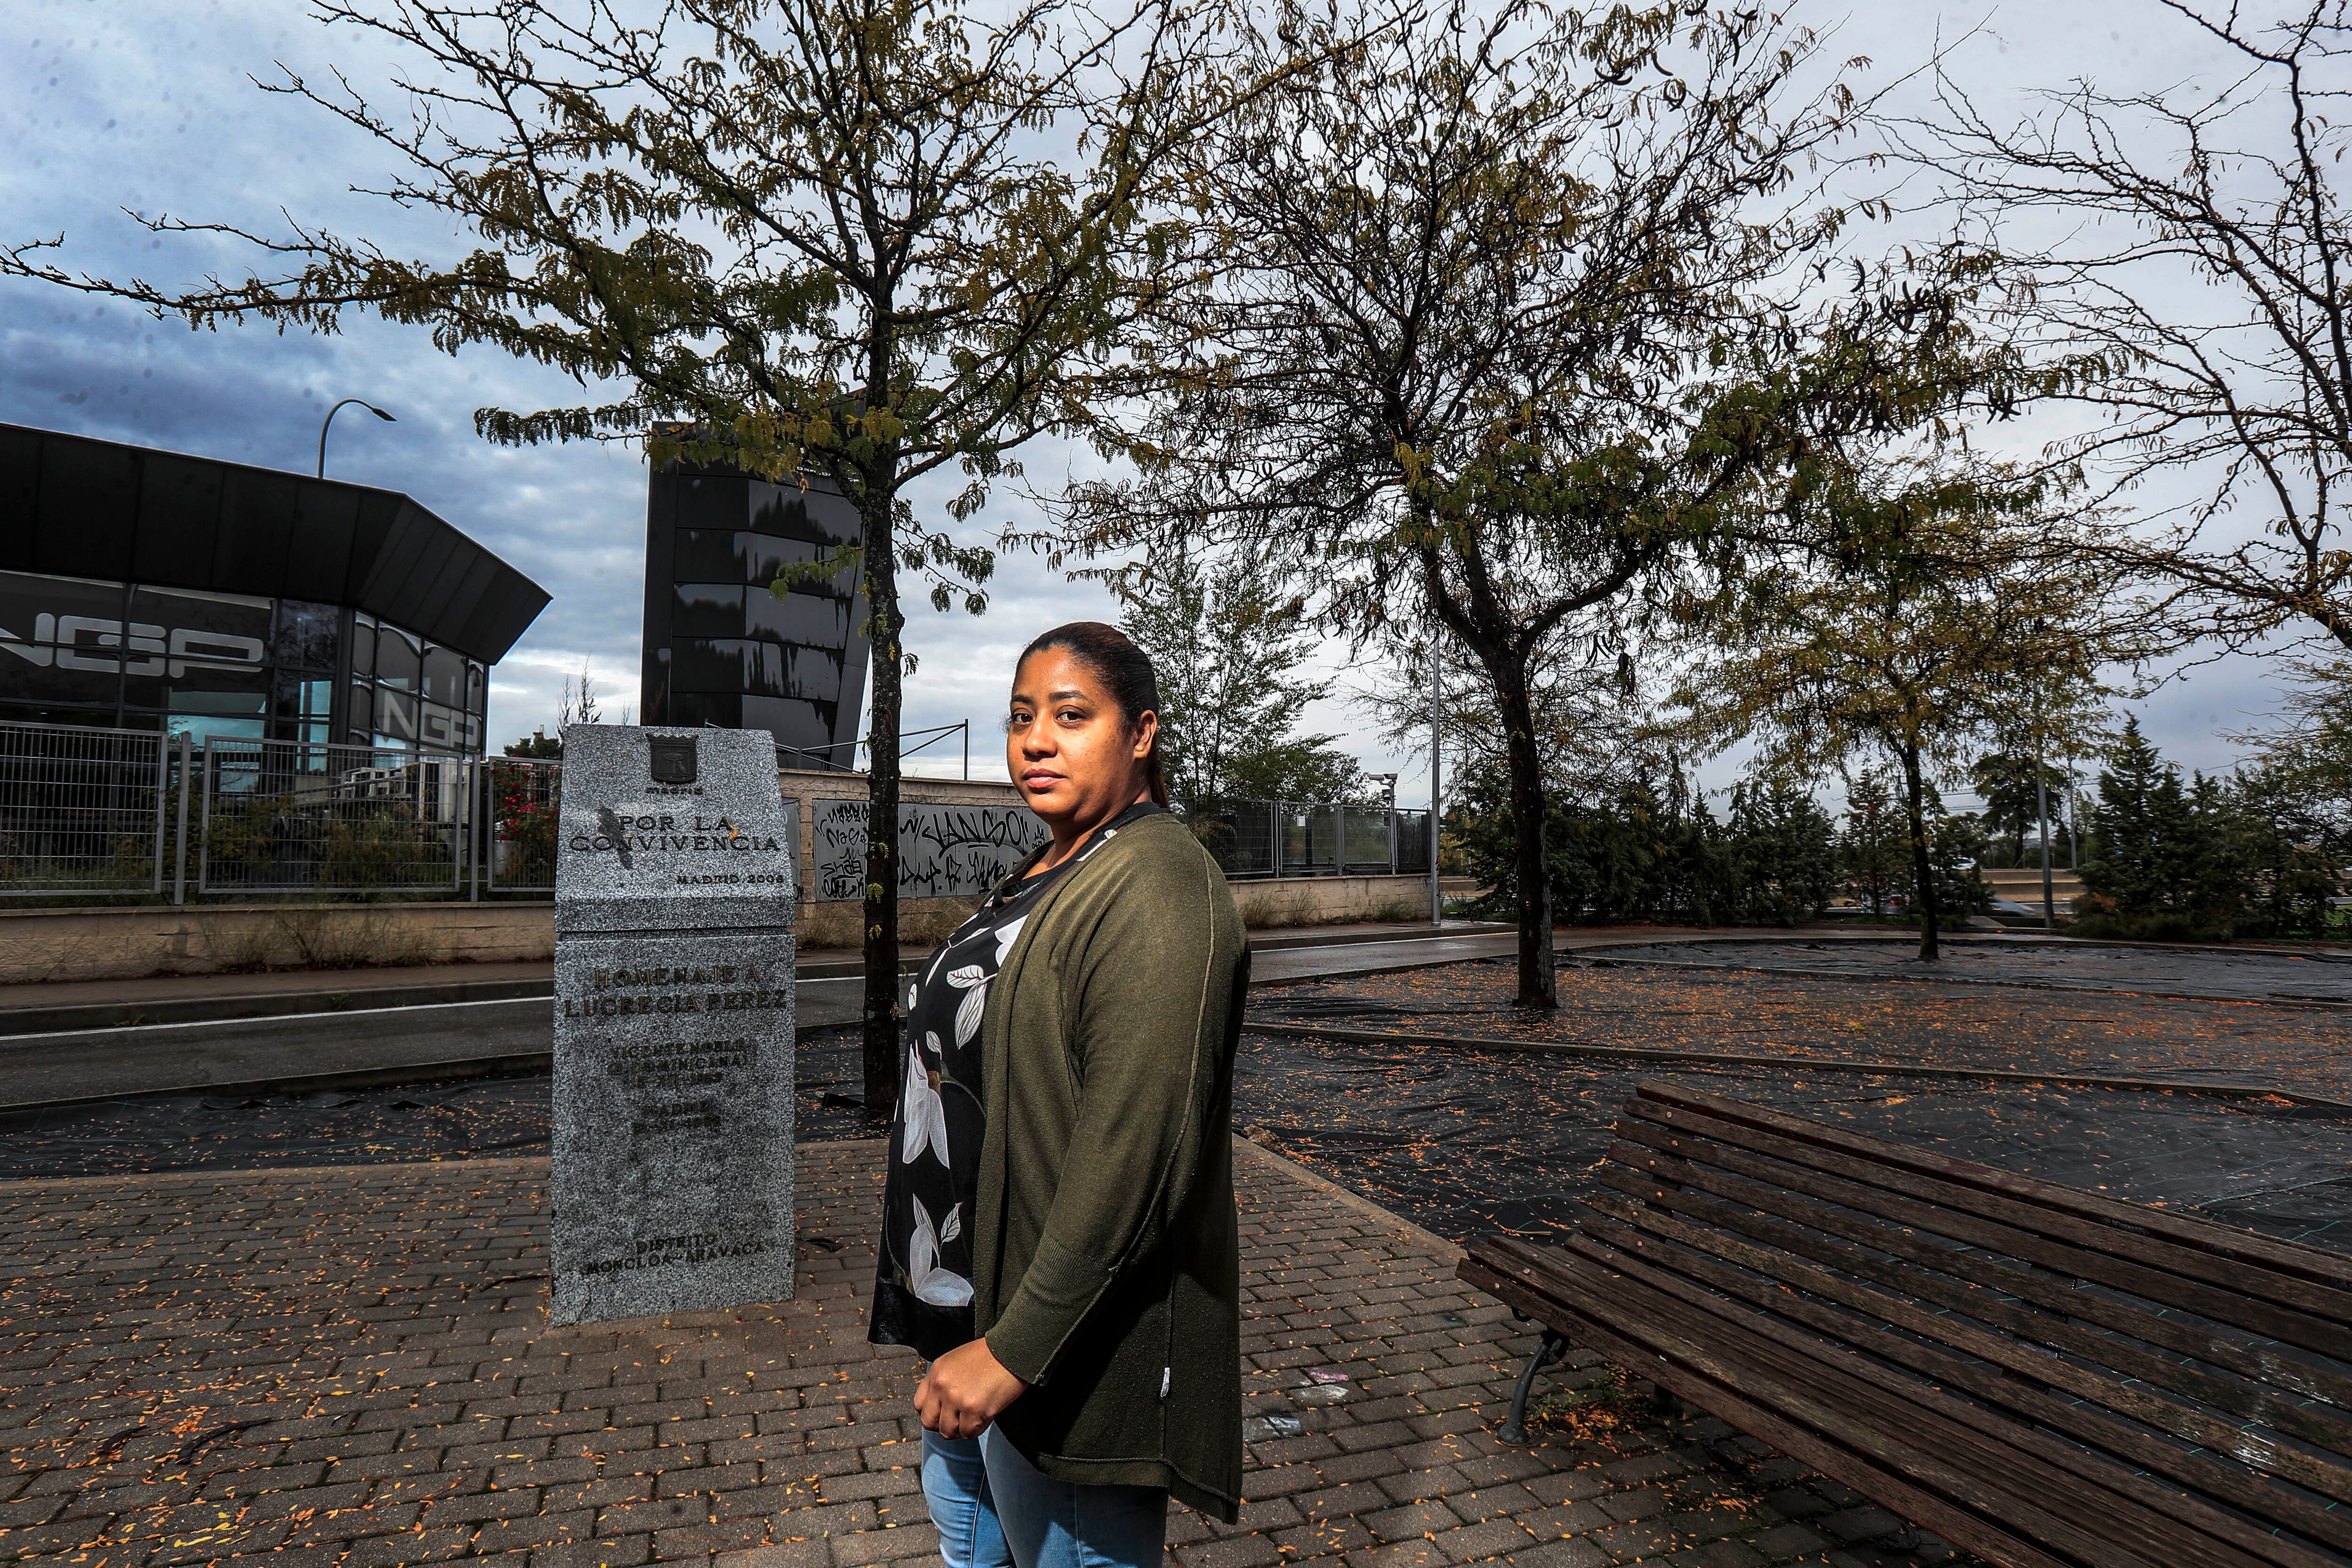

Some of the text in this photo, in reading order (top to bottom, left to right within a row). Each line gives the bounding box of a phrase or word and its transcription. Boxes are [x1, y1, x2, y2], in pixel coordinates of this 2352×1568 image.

[619, 816, 733, 831] POR LA
[569, 836, 781, 852] CONVIVENCIA
[595, 966, 760, 987] HOMENAJE A
[565, 989, 787, 1018] LUCRECIA PEREZ
[610, 1038, 746, 1059] VICENTE NOBLE
[636, 1233, 717, 1254] DISTRITO
